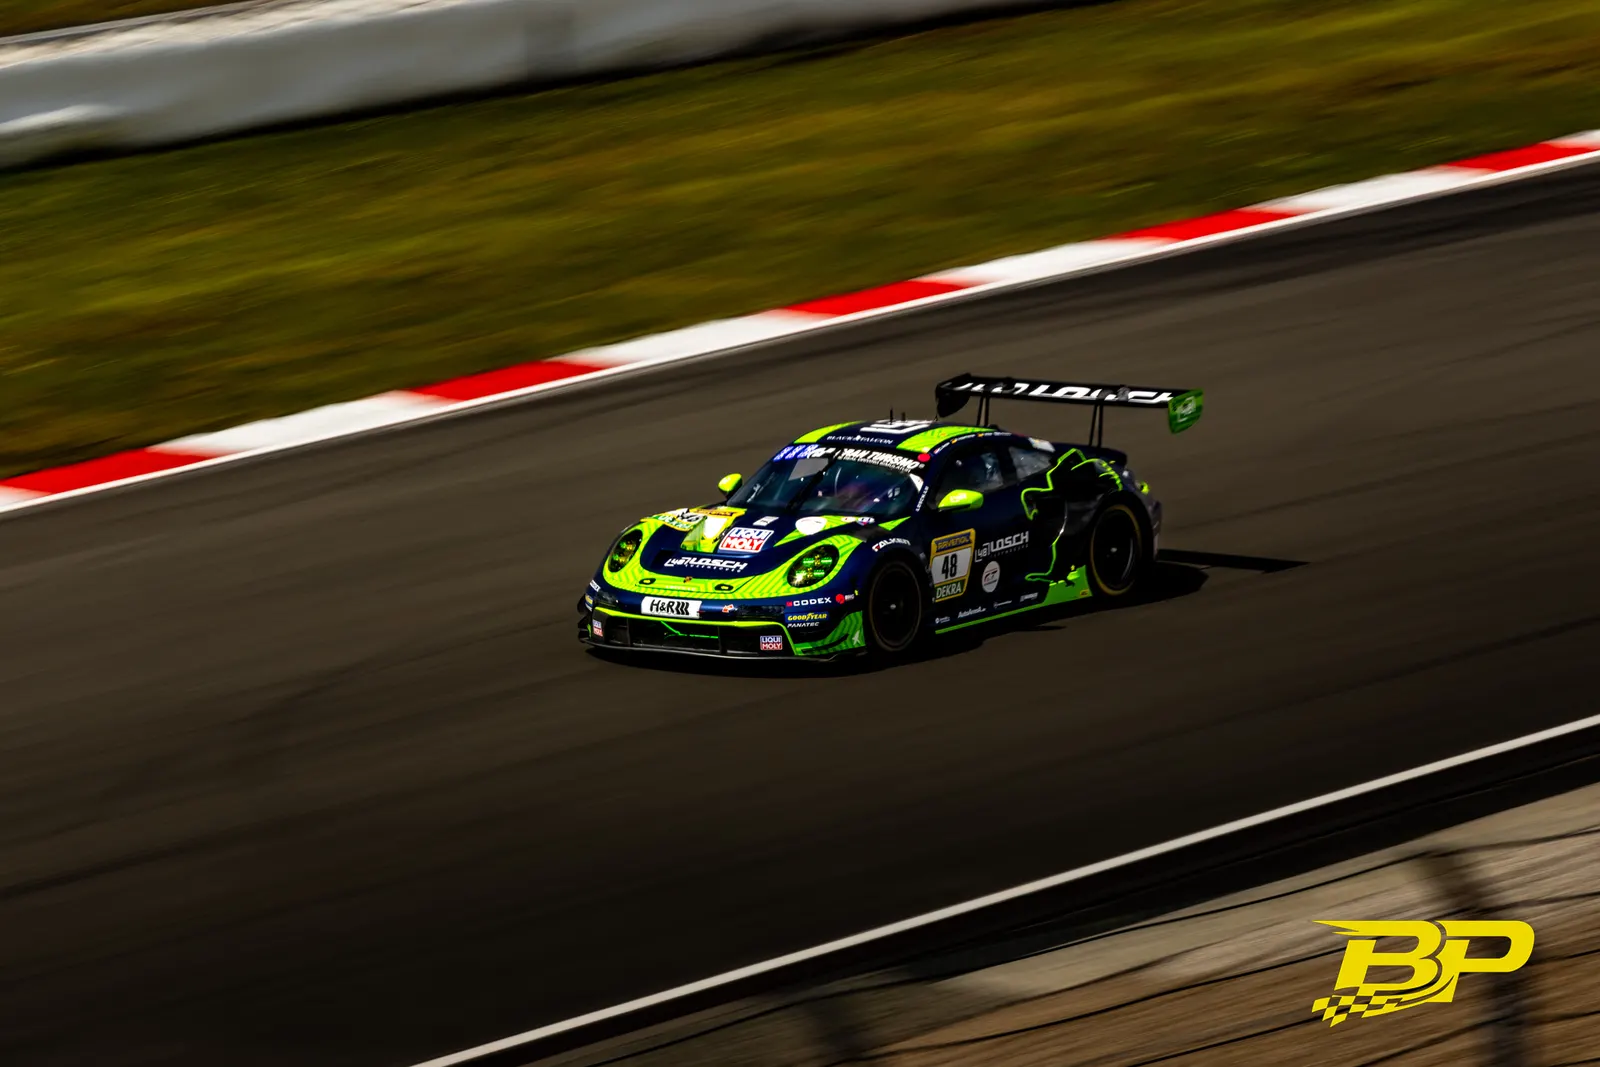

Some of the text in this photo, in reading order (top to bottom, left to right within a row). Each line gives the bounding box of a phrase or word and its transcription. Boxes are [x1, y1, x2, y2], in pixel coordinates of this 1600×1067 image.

[859, 436, 894, 445] FALCON
[731, 528, 770, 540] LIQUI
[723, 537, 765, 551] MOLY
[991, 531, 1029, 552] LOSCH
[689, 557, 748, 571] LOSCH
[941, 553, 958, 579] 48
[935, 582, 962, 599] DEKRA
[650, 599, 675, 614] H&R
[793, 597, 832, 607] CODEX
[787, 611, 828, 622] GOODYEAR
